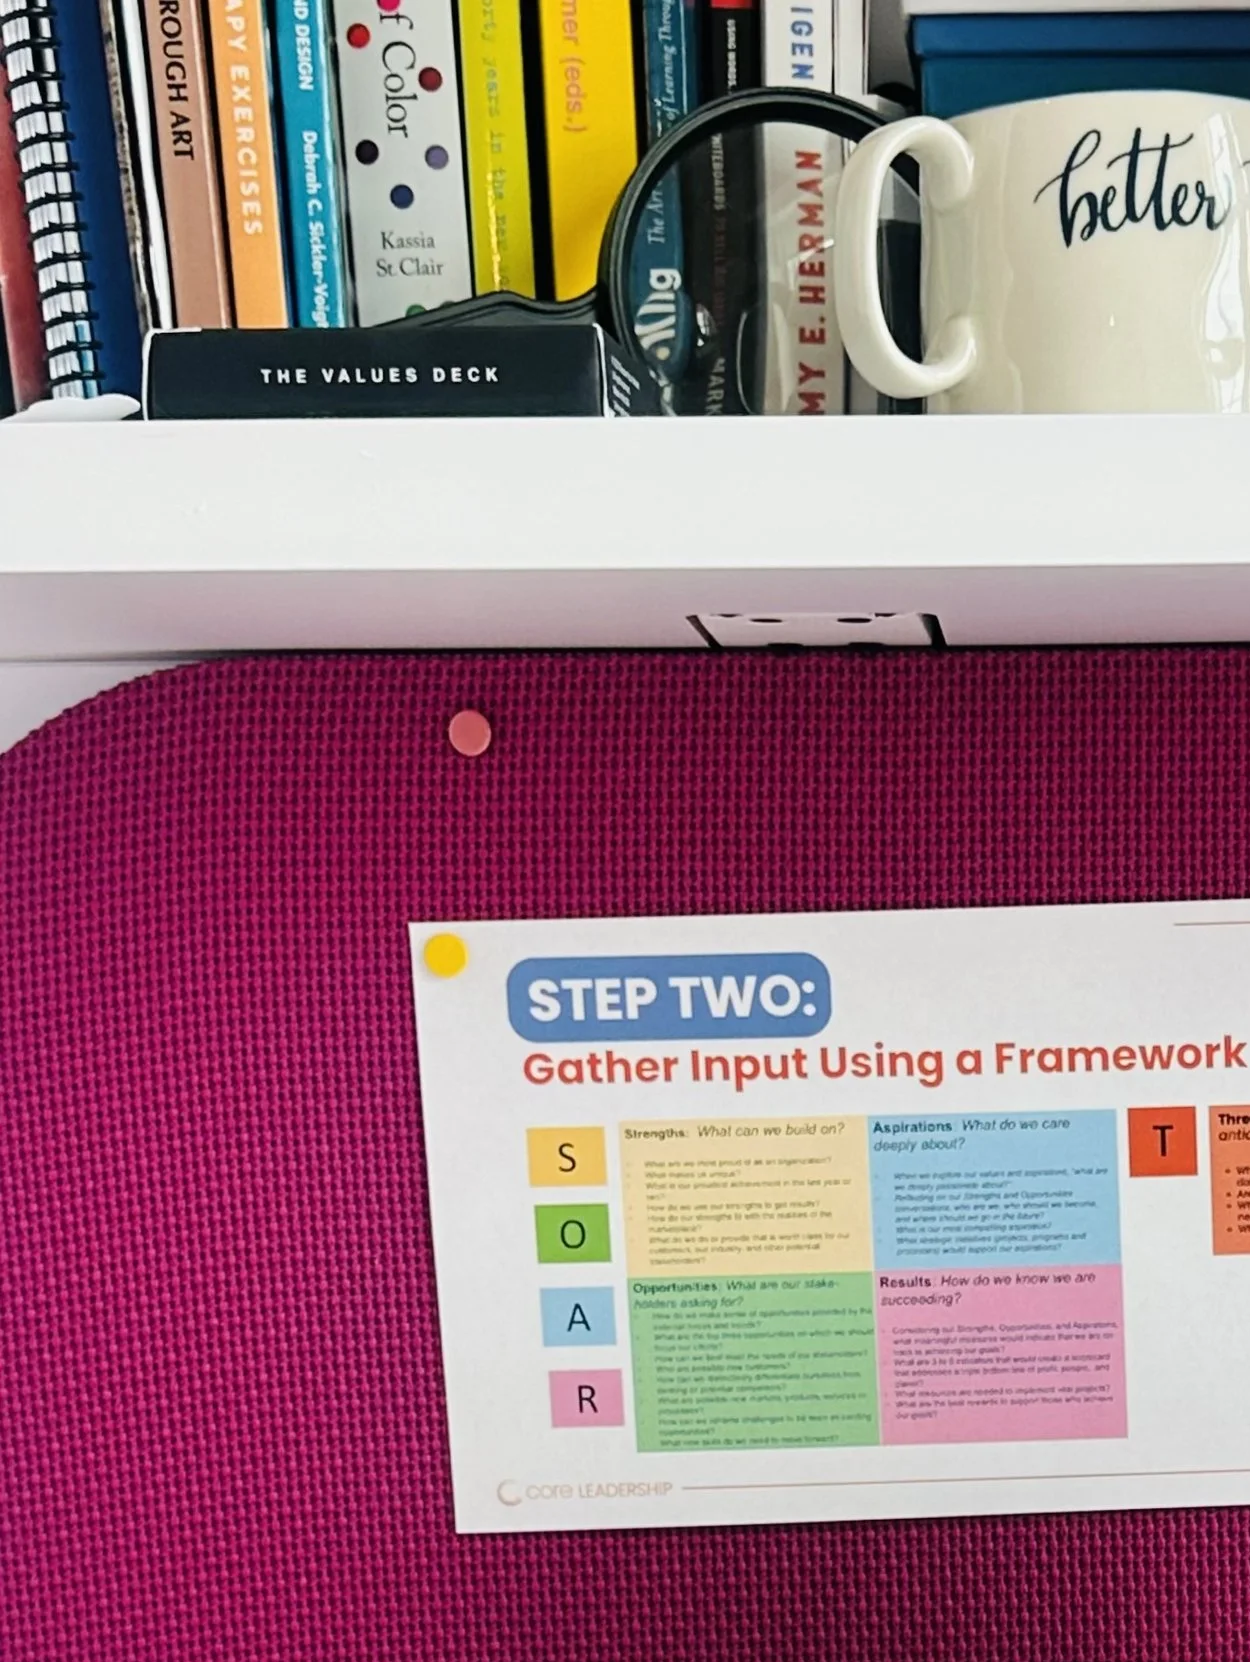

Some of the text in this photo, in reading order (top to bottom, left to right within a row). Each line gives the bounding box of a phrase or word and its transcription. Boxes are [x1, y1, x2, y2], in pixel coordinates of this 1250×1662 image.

[295, 25, 314, 91] DESIGN
[382, 41, 418, 138] Color
[559, 56, 589, 133] (eds.)
[169, 111, 195, 161] ART
[231, 64, 263, 236] EXERCISES
[647, 44, 678, 244] The Learning
[302, 131, 322, 195] Debrah
[1033, 127, 1232, 249] better
[380, 231, 436, 250] Kassia
[796, 149, 827, 346] E. HERMAN
[400, 258, 444, 278] Clair
[260, 367, 501, 385] THE VALUES DECK
[526, 972, 819, 1023] STEP TWO:
[522, 1034, 1248, 1093] Gather Input Using a Framework
[623, 1122, 846, 1142] Strengths: What can we build on?
[961, 1119, 997, 1132] What
[999, 1118, 1017, 1131] do
[1019, 1119, 1041, 1131] we
[1041, 1118, 1071, 1130] care
[873, 1136, 967, 1153] deeply about?
[1152, 1124, 1174, 1158] T
[557, 1142, 578, 1174] S
[559, 1219, 588, 1250] O
[725, 1279, 756, 1293] What
[757, 1280, 780, 1291] are
[780, 1280, 802, 1291] our
[803, 1279, 840, 1291] stake-
[940, 1274, 970, 1288] How
[972, 1274, 991, 1287] do
[993, 1275, 1013, 1286] we
[1014, 1272, 1050, 1286] know
[1052, 1273, 1073, 1285] we
[1074, 1272, 1098, 1284] are
[632, 1294, 746, 1311] holders asking for?
[880, 1291, 963, 1308] succeeding?
[566, 1303, 592, 1333] A
[577, 1384, 599, 1414] R
[525, 1482, 674, 1500] core LEADERSHIP
